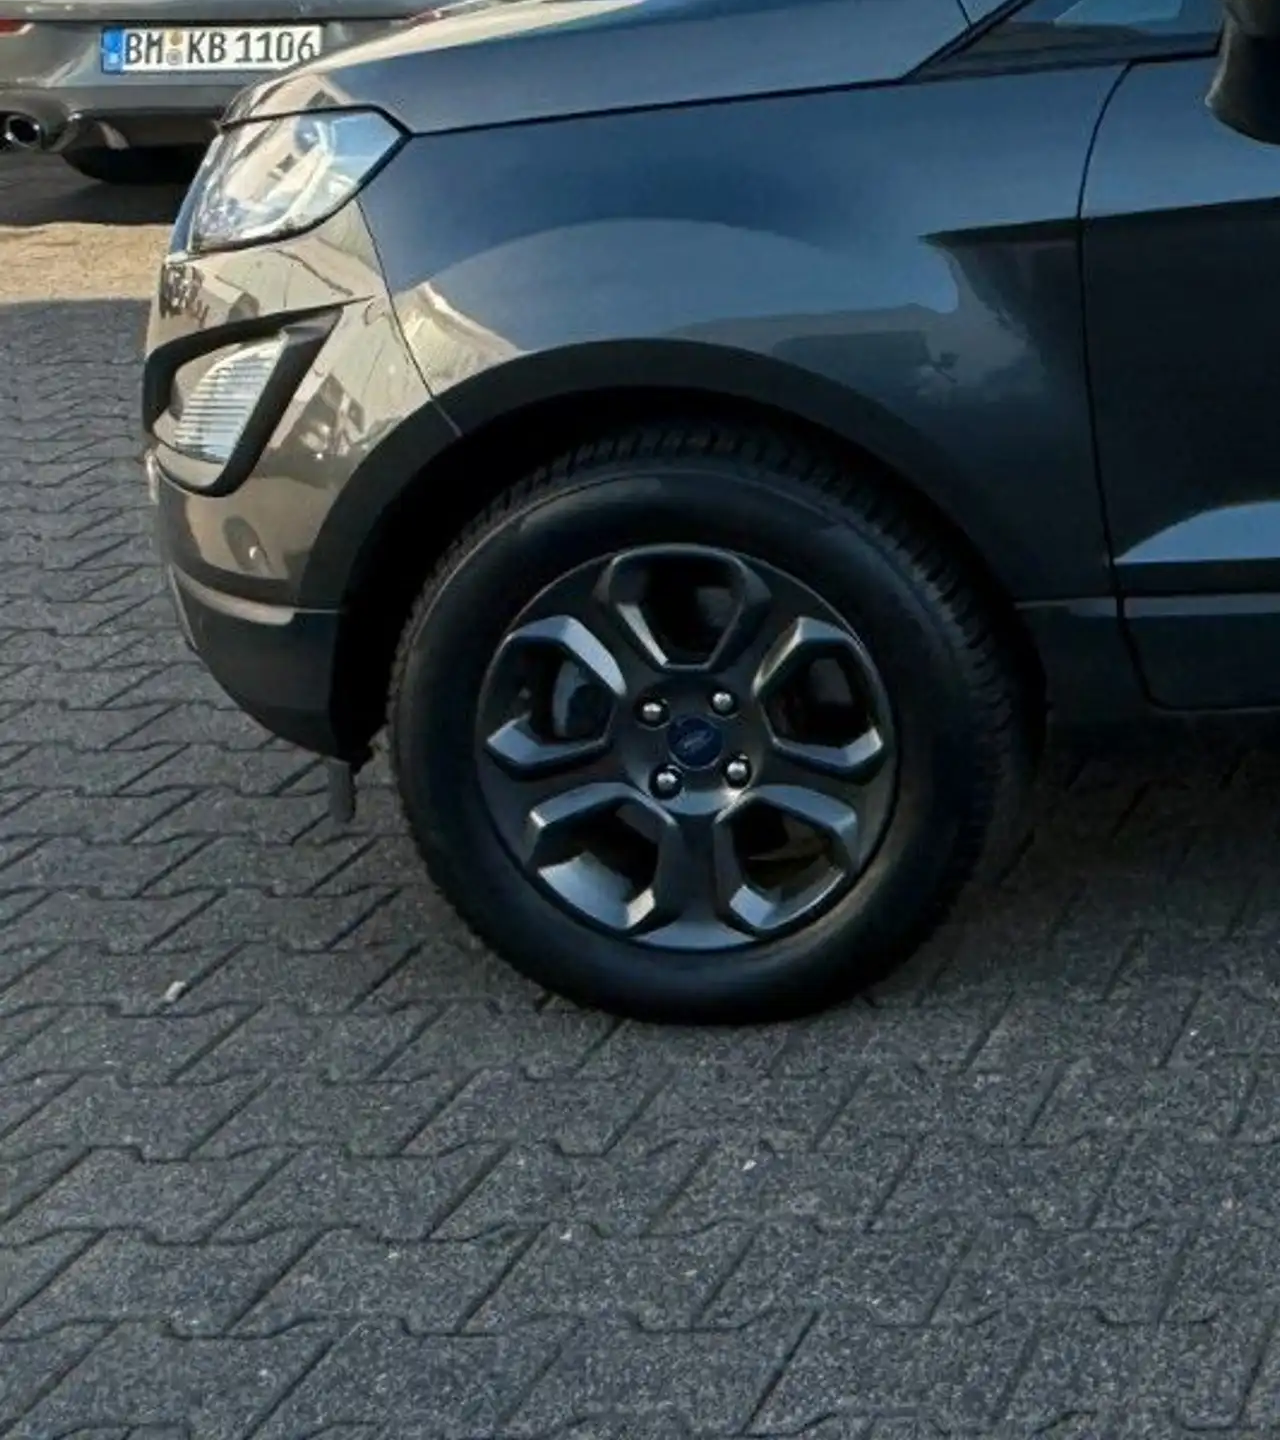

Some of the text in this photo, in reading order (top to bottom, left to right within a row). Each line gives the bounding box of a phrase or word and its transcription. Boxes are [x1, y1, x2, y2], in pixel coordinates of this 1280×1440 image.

[125, 30, 316, 64] BM KB 1106
